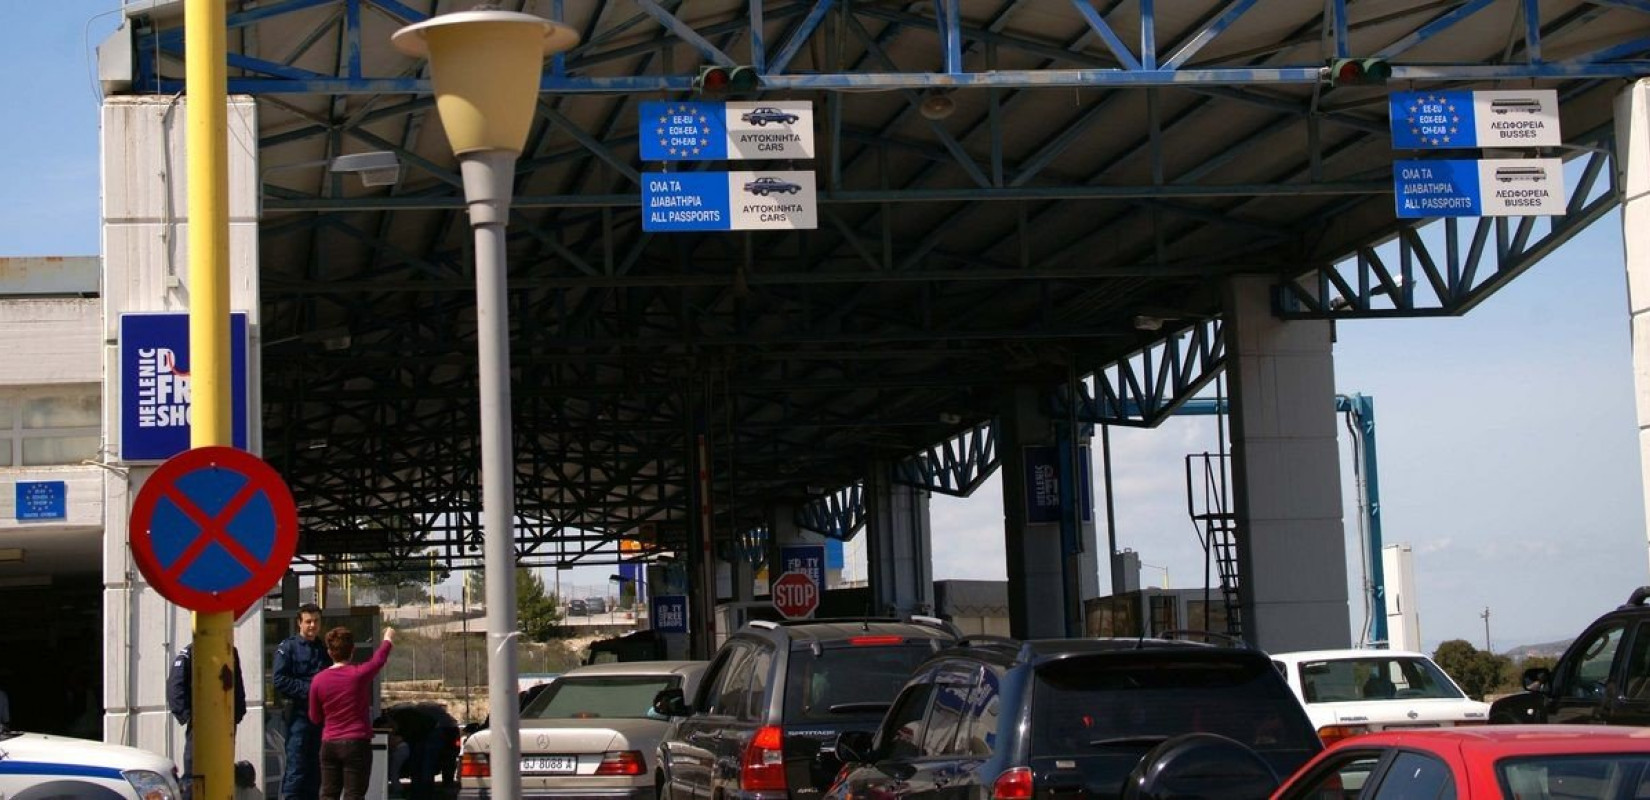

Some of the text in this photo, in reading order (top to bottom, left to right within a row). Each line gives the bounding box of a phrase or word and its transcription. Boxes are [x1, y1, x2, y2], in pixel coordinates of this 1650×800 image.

[1491, 121, 1544, 130] ΛΕΩΦΟΡΕΙΑ
[740, 134, 801, 142] ΑΥΤΟΚΙΝΗΤΑ
[1500, 130, 1537, 138] BUSSES
[758, 143, 784, 151] CARS
[1402, 168, 1432, 180] ΟΛΑ ΤΑ
[650, 181, 682, 192] ΟΛΑ ΤΑ
[1404, 184, 1453, 194] ΔΙΑΒΑΤΗΡΙΑ
[1496, 190, 1549, 198] ΛΕΩΦΟΡΕΙΑ
[650, 196, 702, 208] ΔΙΑΒΑΤΗΡΙΑ
[1404, 198, 1472, 210] ALL PASSPORTS
[1504, 198, 1542, 207] BUSSES
[743, 204, 803, 213] ΑΥΤΟΚΙΝΗΤΑ
[651, 210, 720, 222] ALL PASSPORTS
[760, 214, 786, 222] CARS
[139, 348, 156, 427] HELLENIC
[157, 374, 191, 404] FR
[776, 584, 814, 607] STOP
